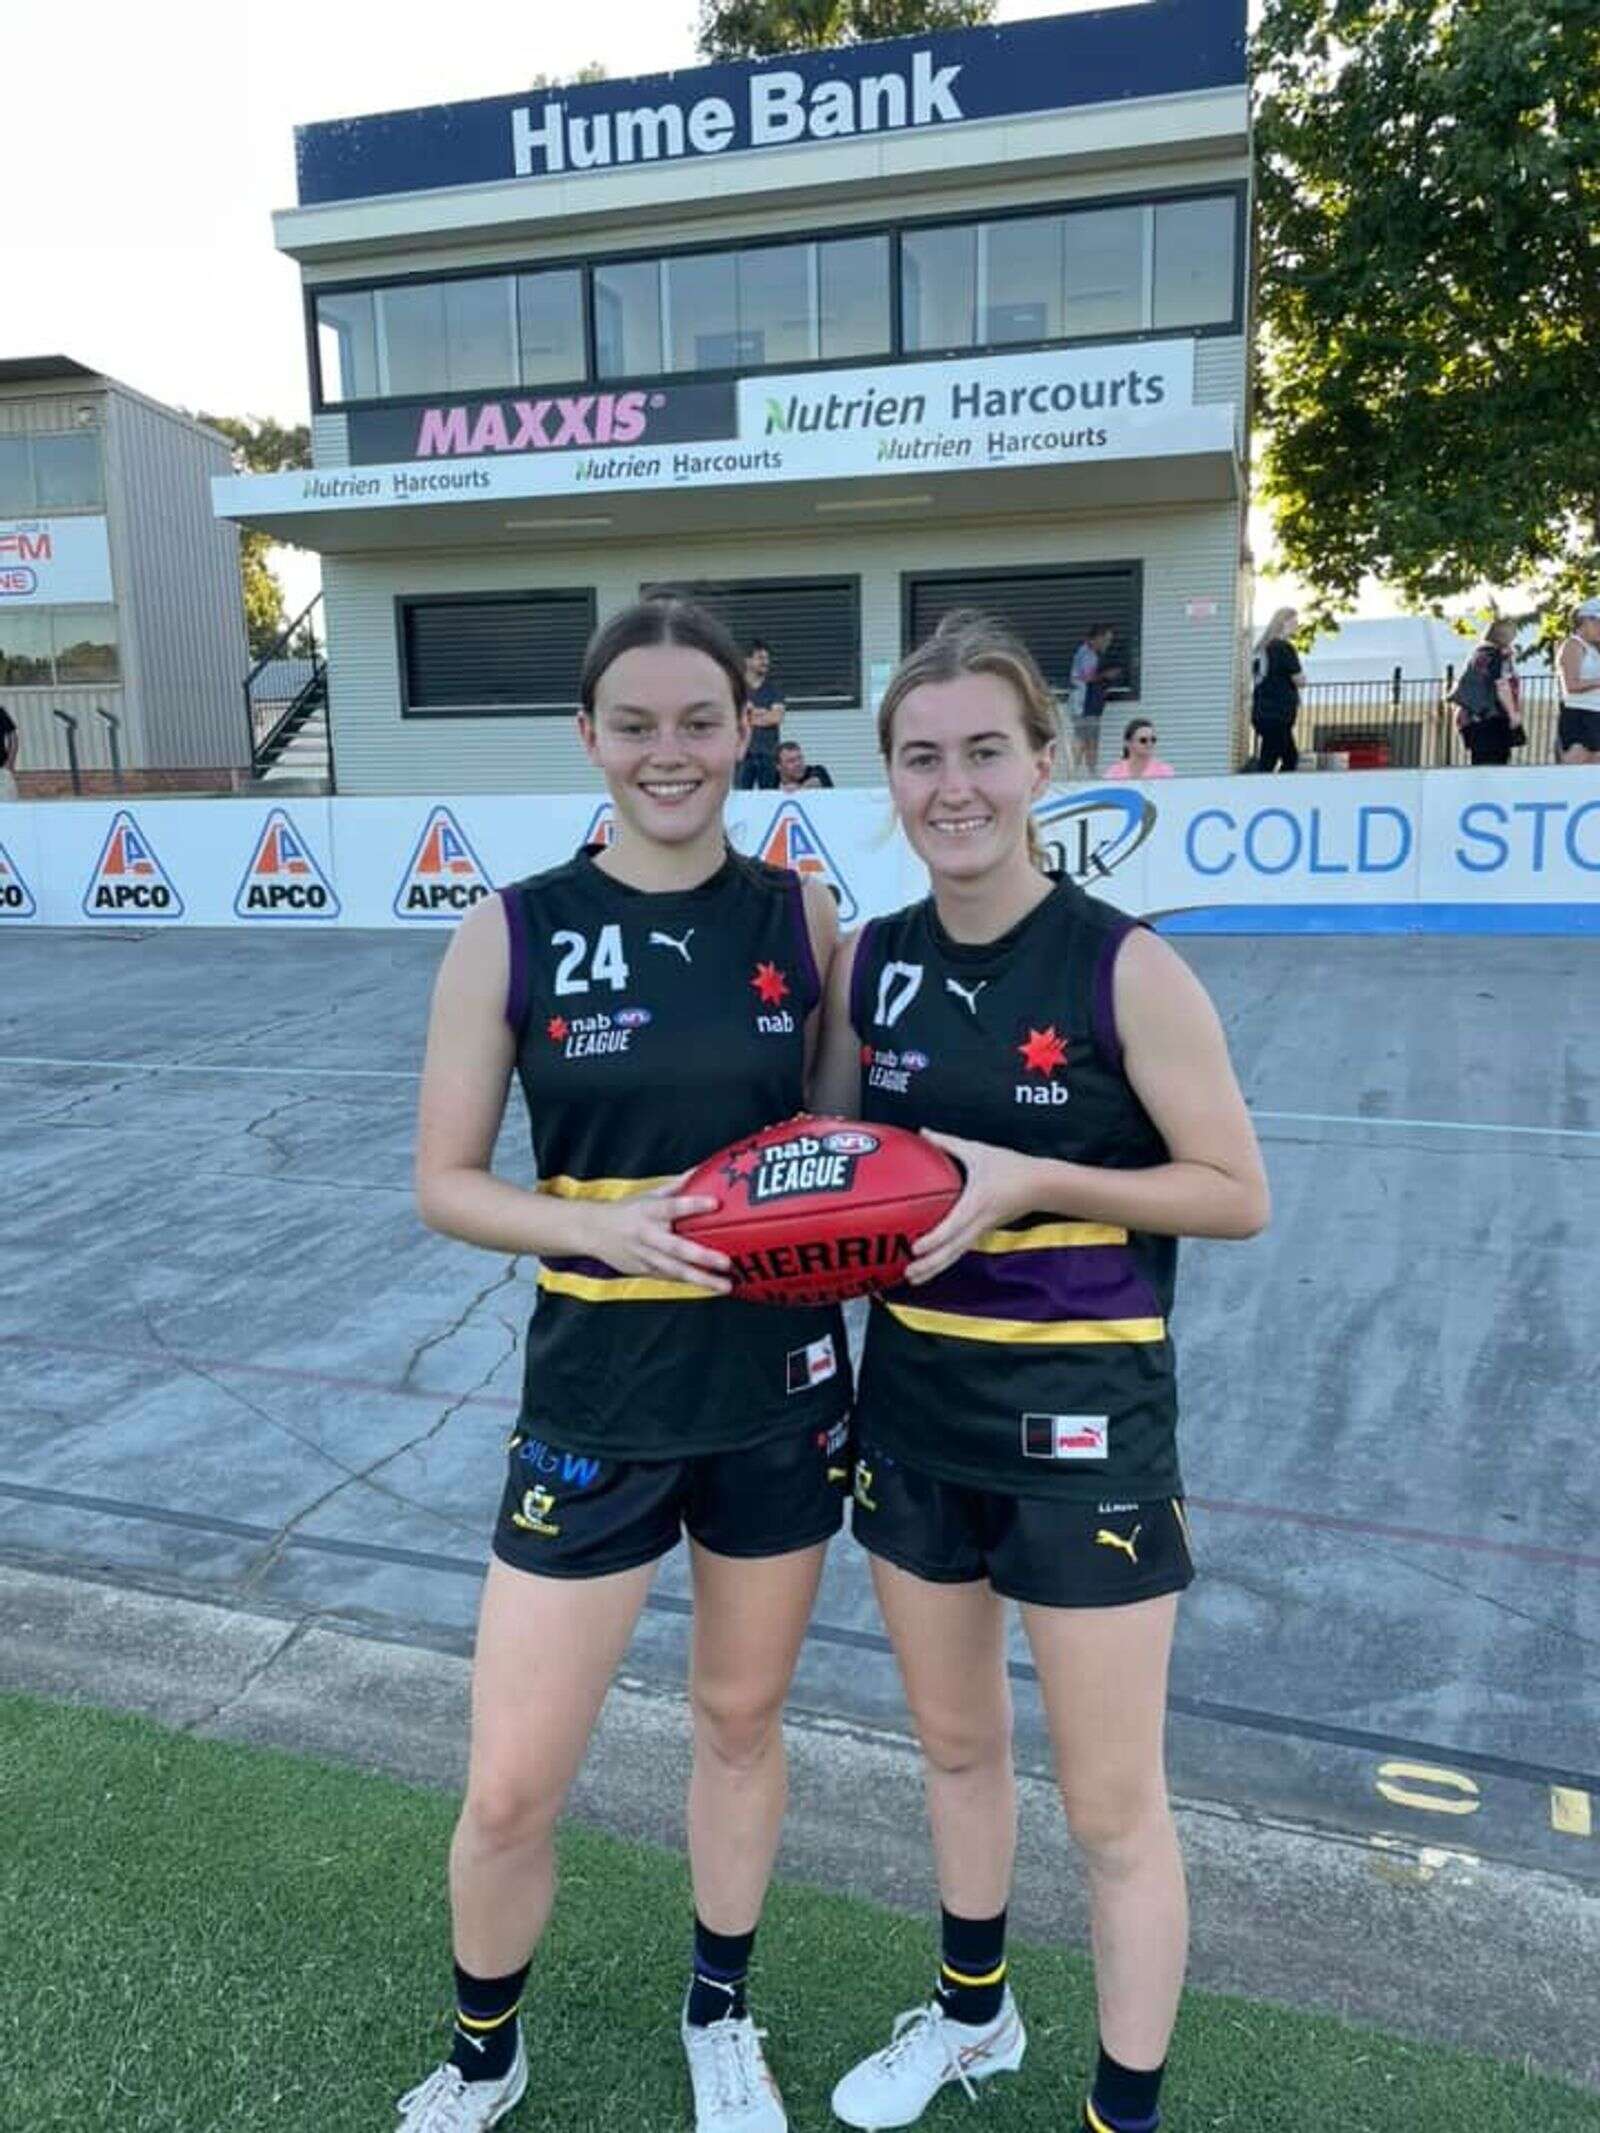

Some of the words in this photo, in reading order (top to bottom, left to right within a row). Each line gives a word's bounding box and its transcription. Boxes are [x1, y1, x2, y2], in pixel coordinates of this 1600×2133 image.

[511, 97, 735, 176] Hume
[749, 51, 964, 146] Bank
[765, 389, 925, 435] Nutrien
[951, 371, 1165, 421] Harcourts
[877, 430, 971, 462] Nutrien
[988, 426, 1108, 457] Harcourts
[575, 454, 662, 481] Nutrien
[673, 450, 782, 476] Harcourts
[303, 474, 381, 500] Nutrien
[393, 468, 490, 494] Harcourts
[1185, 804, 1413, 876] COLD
[95, 884, 170, 908] APCO
[247, 884, 326, 908] APCO
[551, 924, 629, 996] 24
[571, 1013, 611, 1033] nab
[757, 1010, 794, 1033] nab
[564, 1029, 633, 1059] LEAGUE
[1015, 1081, 1069, 1105] nab
[764, 1137, 820, 1162] nab
[757, 1154, 849, 1198] LEAGUE
